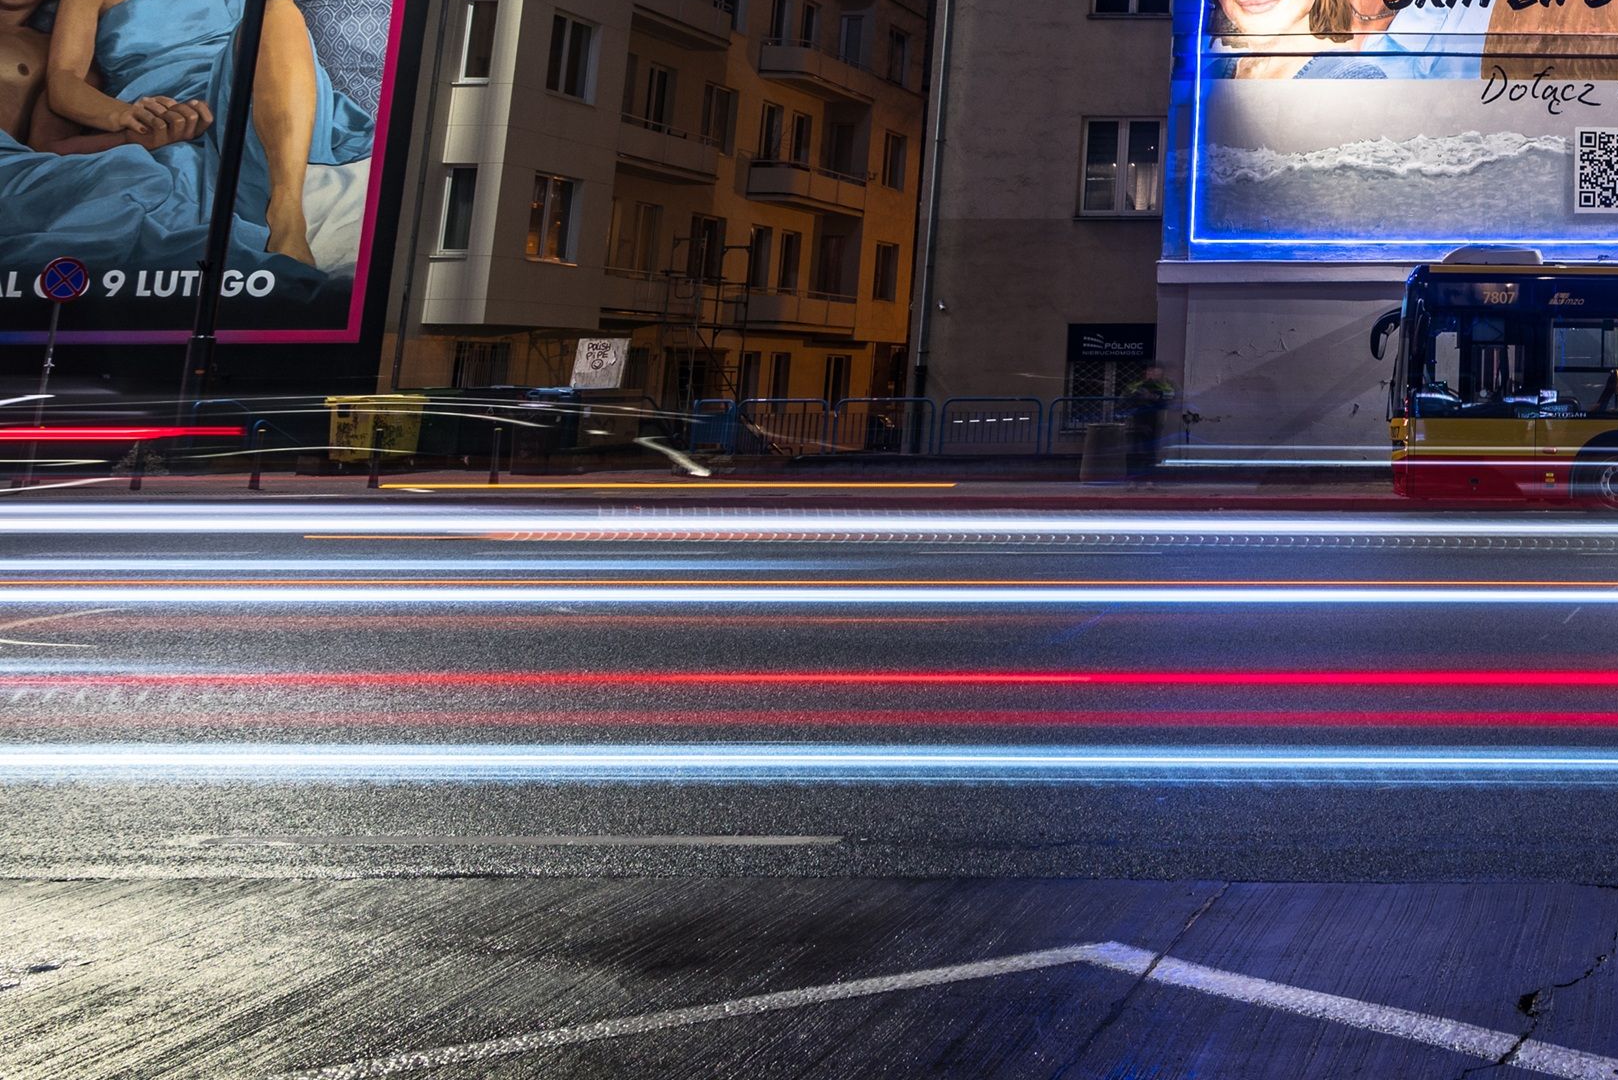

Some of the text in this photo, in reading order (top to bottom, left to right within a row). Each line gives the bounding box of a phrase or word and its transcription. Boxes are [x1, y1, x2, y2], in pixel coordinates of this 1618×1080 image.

[1481, 65, 1601, 114] Dołącz
[0, 271, 22, 298] L
[102, 269, 126, 298] 9
[136, 269, 275, 298] LUTGO
[1483, 291, 1516, 304] 7807
